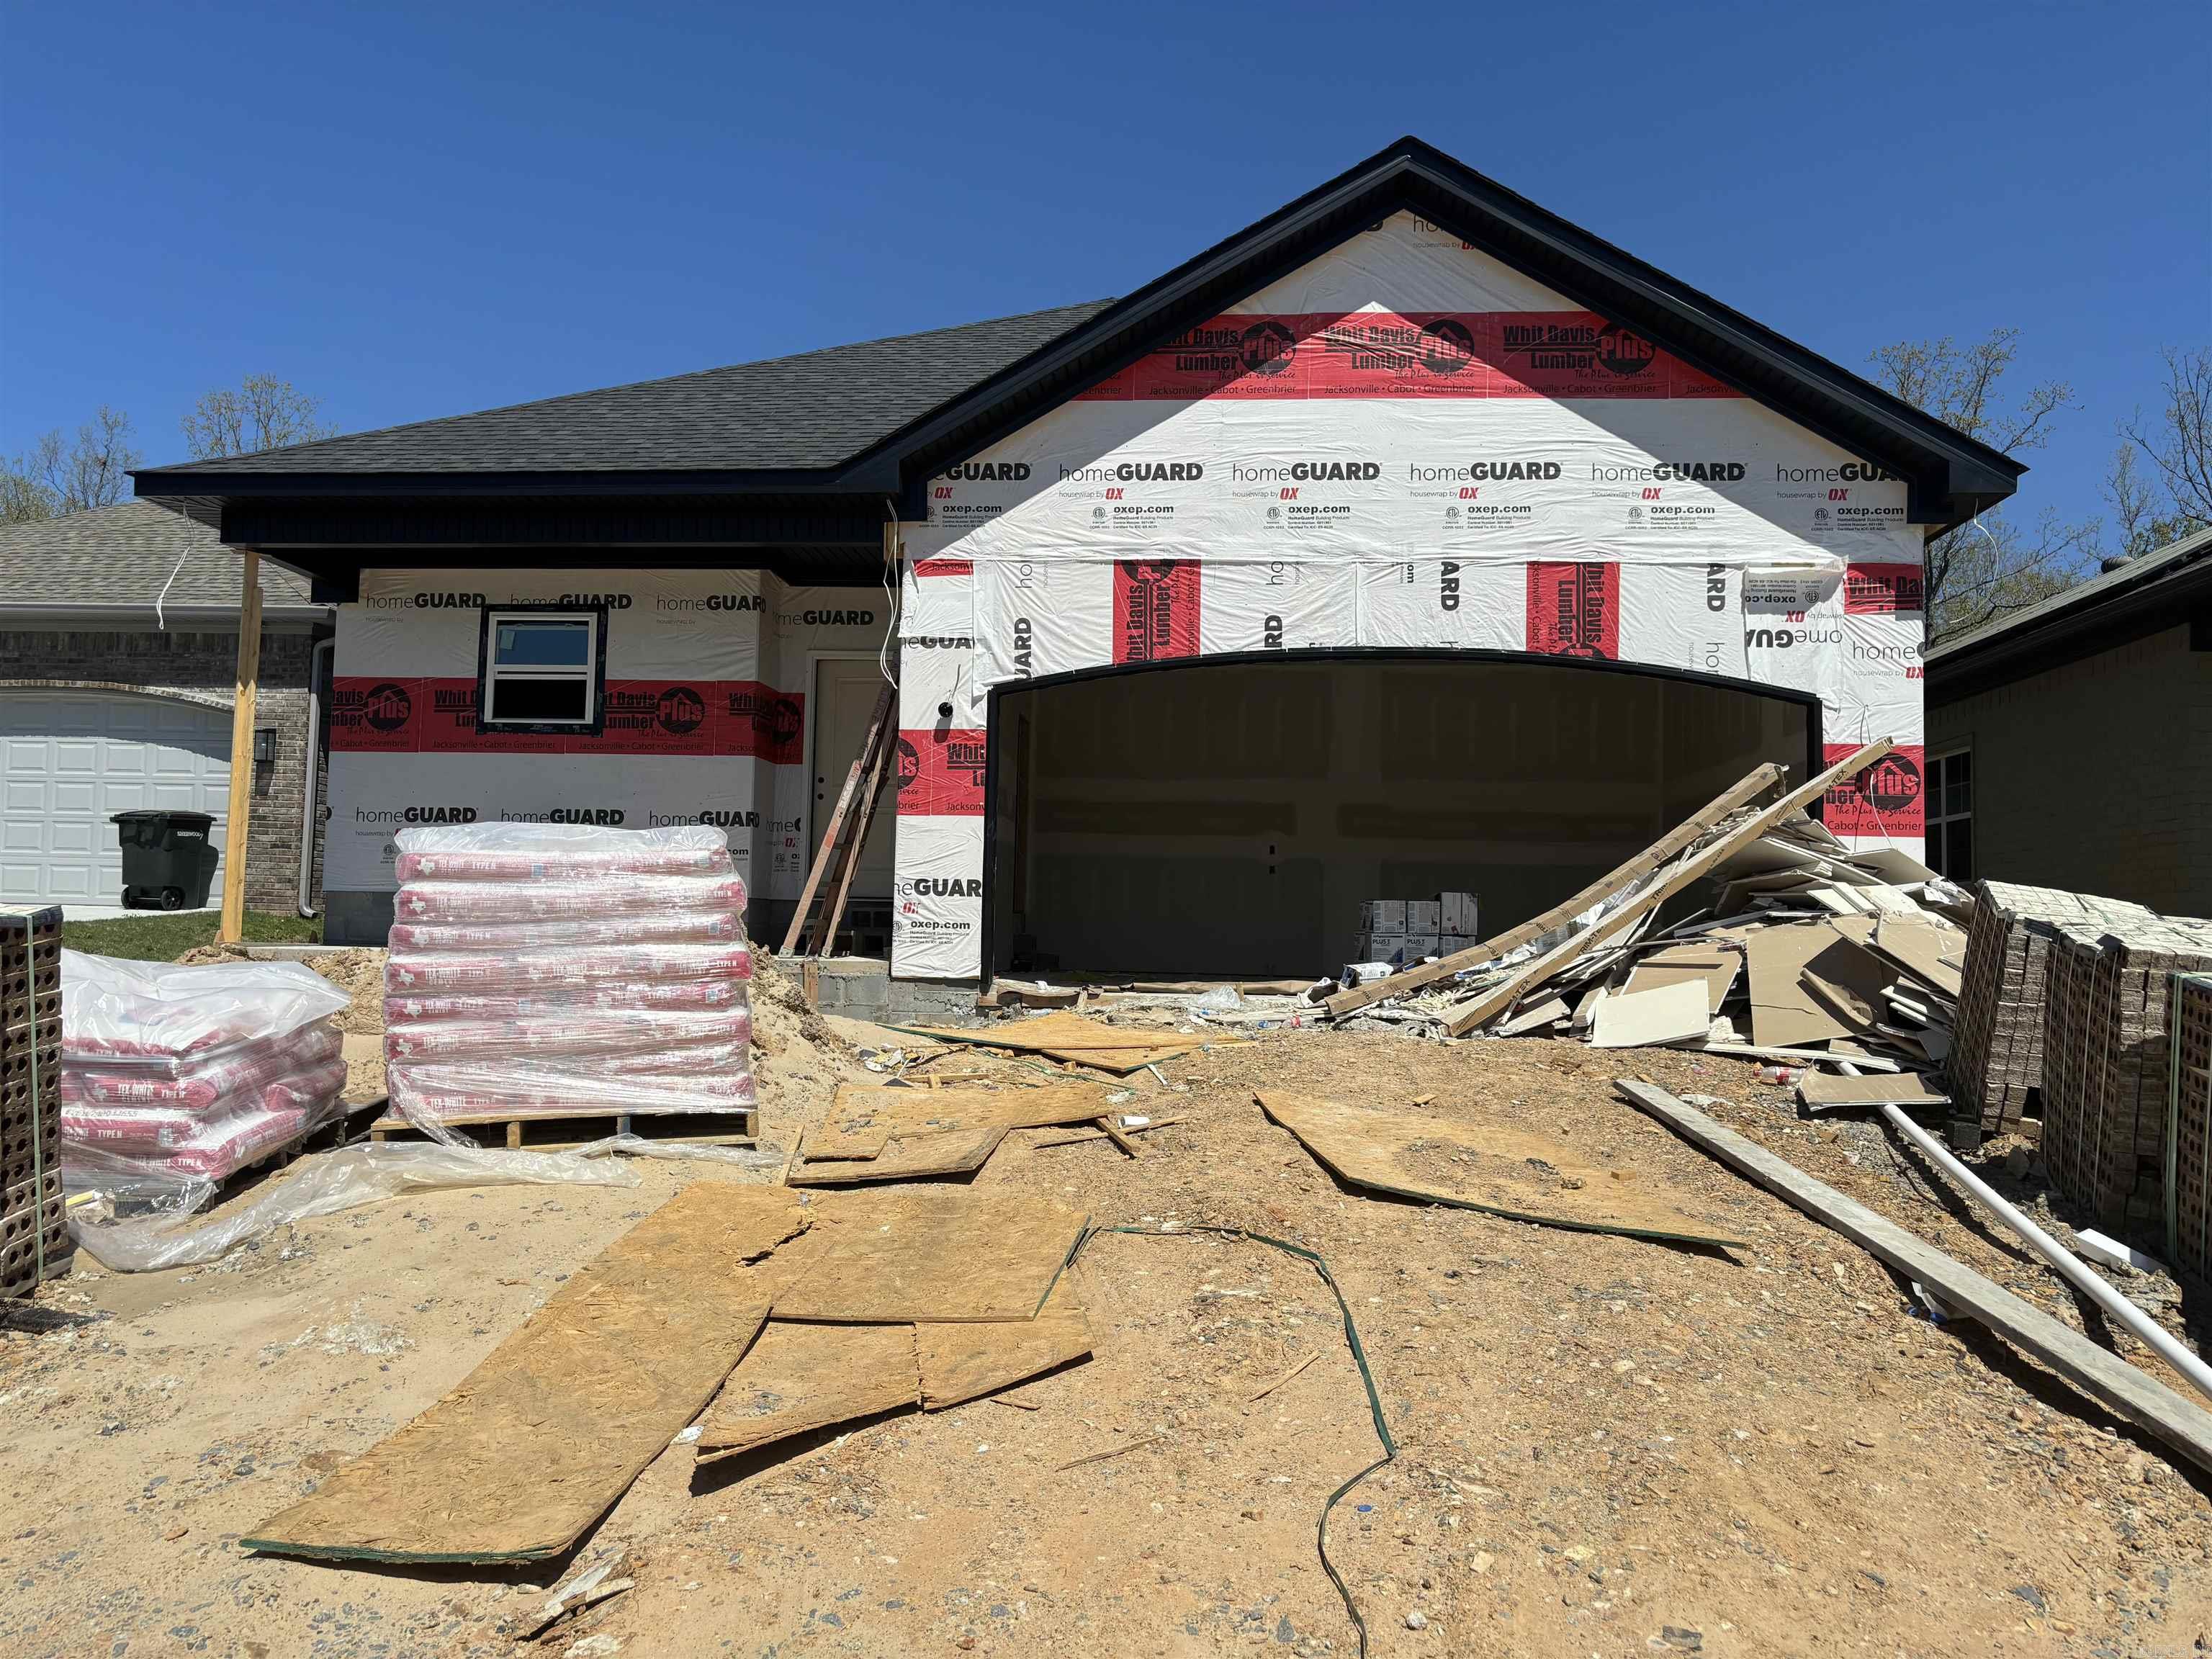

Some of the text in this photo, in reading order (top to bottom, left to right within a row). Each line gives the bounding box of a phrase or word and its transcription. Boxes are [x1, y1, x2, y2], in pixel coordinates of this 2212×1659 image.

[1368, 326, 1413, 342] Davis
[1503, 325, 1594, 342] Whit Davis
[1175, 354, 1238, 372] Lumber
[1352, 352, 1414, 369] Lumber
[1531, 351, 1595, 369] Lumber
[1149, 385, 1296, 395] Jacksonville Cabot Greenbrier
[1325, 385, 1475, 394] Jacksonville Cabot Greenbrier
[1503, 385, 1656, 394] Jacksonville Cabot Greenbrier
[935, 463, 1031, 481] GUARD
[1059, 462, 1203, 481] homeGUARD
[1233, 462, 1380, 481] homeGUARD
[1411, 462, 1561, 481] homeGUARD
[1592, 463, 1745, 481] homeGUARD
[934, 487, 954, 498] OX
[1059, 487, 1124, 500] housewrap by OX
[1233, 487, 1300, 500] housewrap by OX
[1411, 487, 1479, 499] housewrap by OX
[1642, 487, 1662, 500] OX
[1777, 491, 1816, 500] housewrap
[1828, 488, 1848, 500] OX
[943, 505, 1002, 513] oxep.com
[1114, 505, 1174, 514] oxep.com
[1289, 505, 1350, 514] oxep.com
[1468, 505, 1531, 514] oxep.com
[1651, 506, 1715, 515] oxep.com
[1838, 508, 1903, 516] oxep.com
[367, 593, 486, 608] homeGUARD
[1187, 583, 1195, 610] Cabot
[1532, 562, 1542, 644] cksonville Cabot
[1745, 595, 1797, 605] oxep.co
[1126, 585, 1143, 630] Davis
[1558, 580, 1577, 643] Lumber
[1154, 584, 1170, 646] Lumber
[1586, 597, 1604, 643] Davis
[1786, 611, 1805, 623] OX
[1853, 667, 1924, 679] housewrap by OX
[335, 689, 364, 703] avis
[435, 690, 467, 703] Whit
[617, 691, 656, 706] Davis
[433, 740, 477, 749] Jacksonville
[662, 742, 703, 751] Greenbrier
[899, 801, 922, 809] brier
[1835, 804, 1851, 815] The
[356, 806, 477, 823] homeGUARD
[502, 809, 624, 825] homeGUARD
[1827, 820, 1922, 831] Cabot Greenbrier
[911, 921, 970, 930] oxep.com
[98, 1129, 116, 1138] TYPE
[177, 1158, 195, 1166] TYPE
